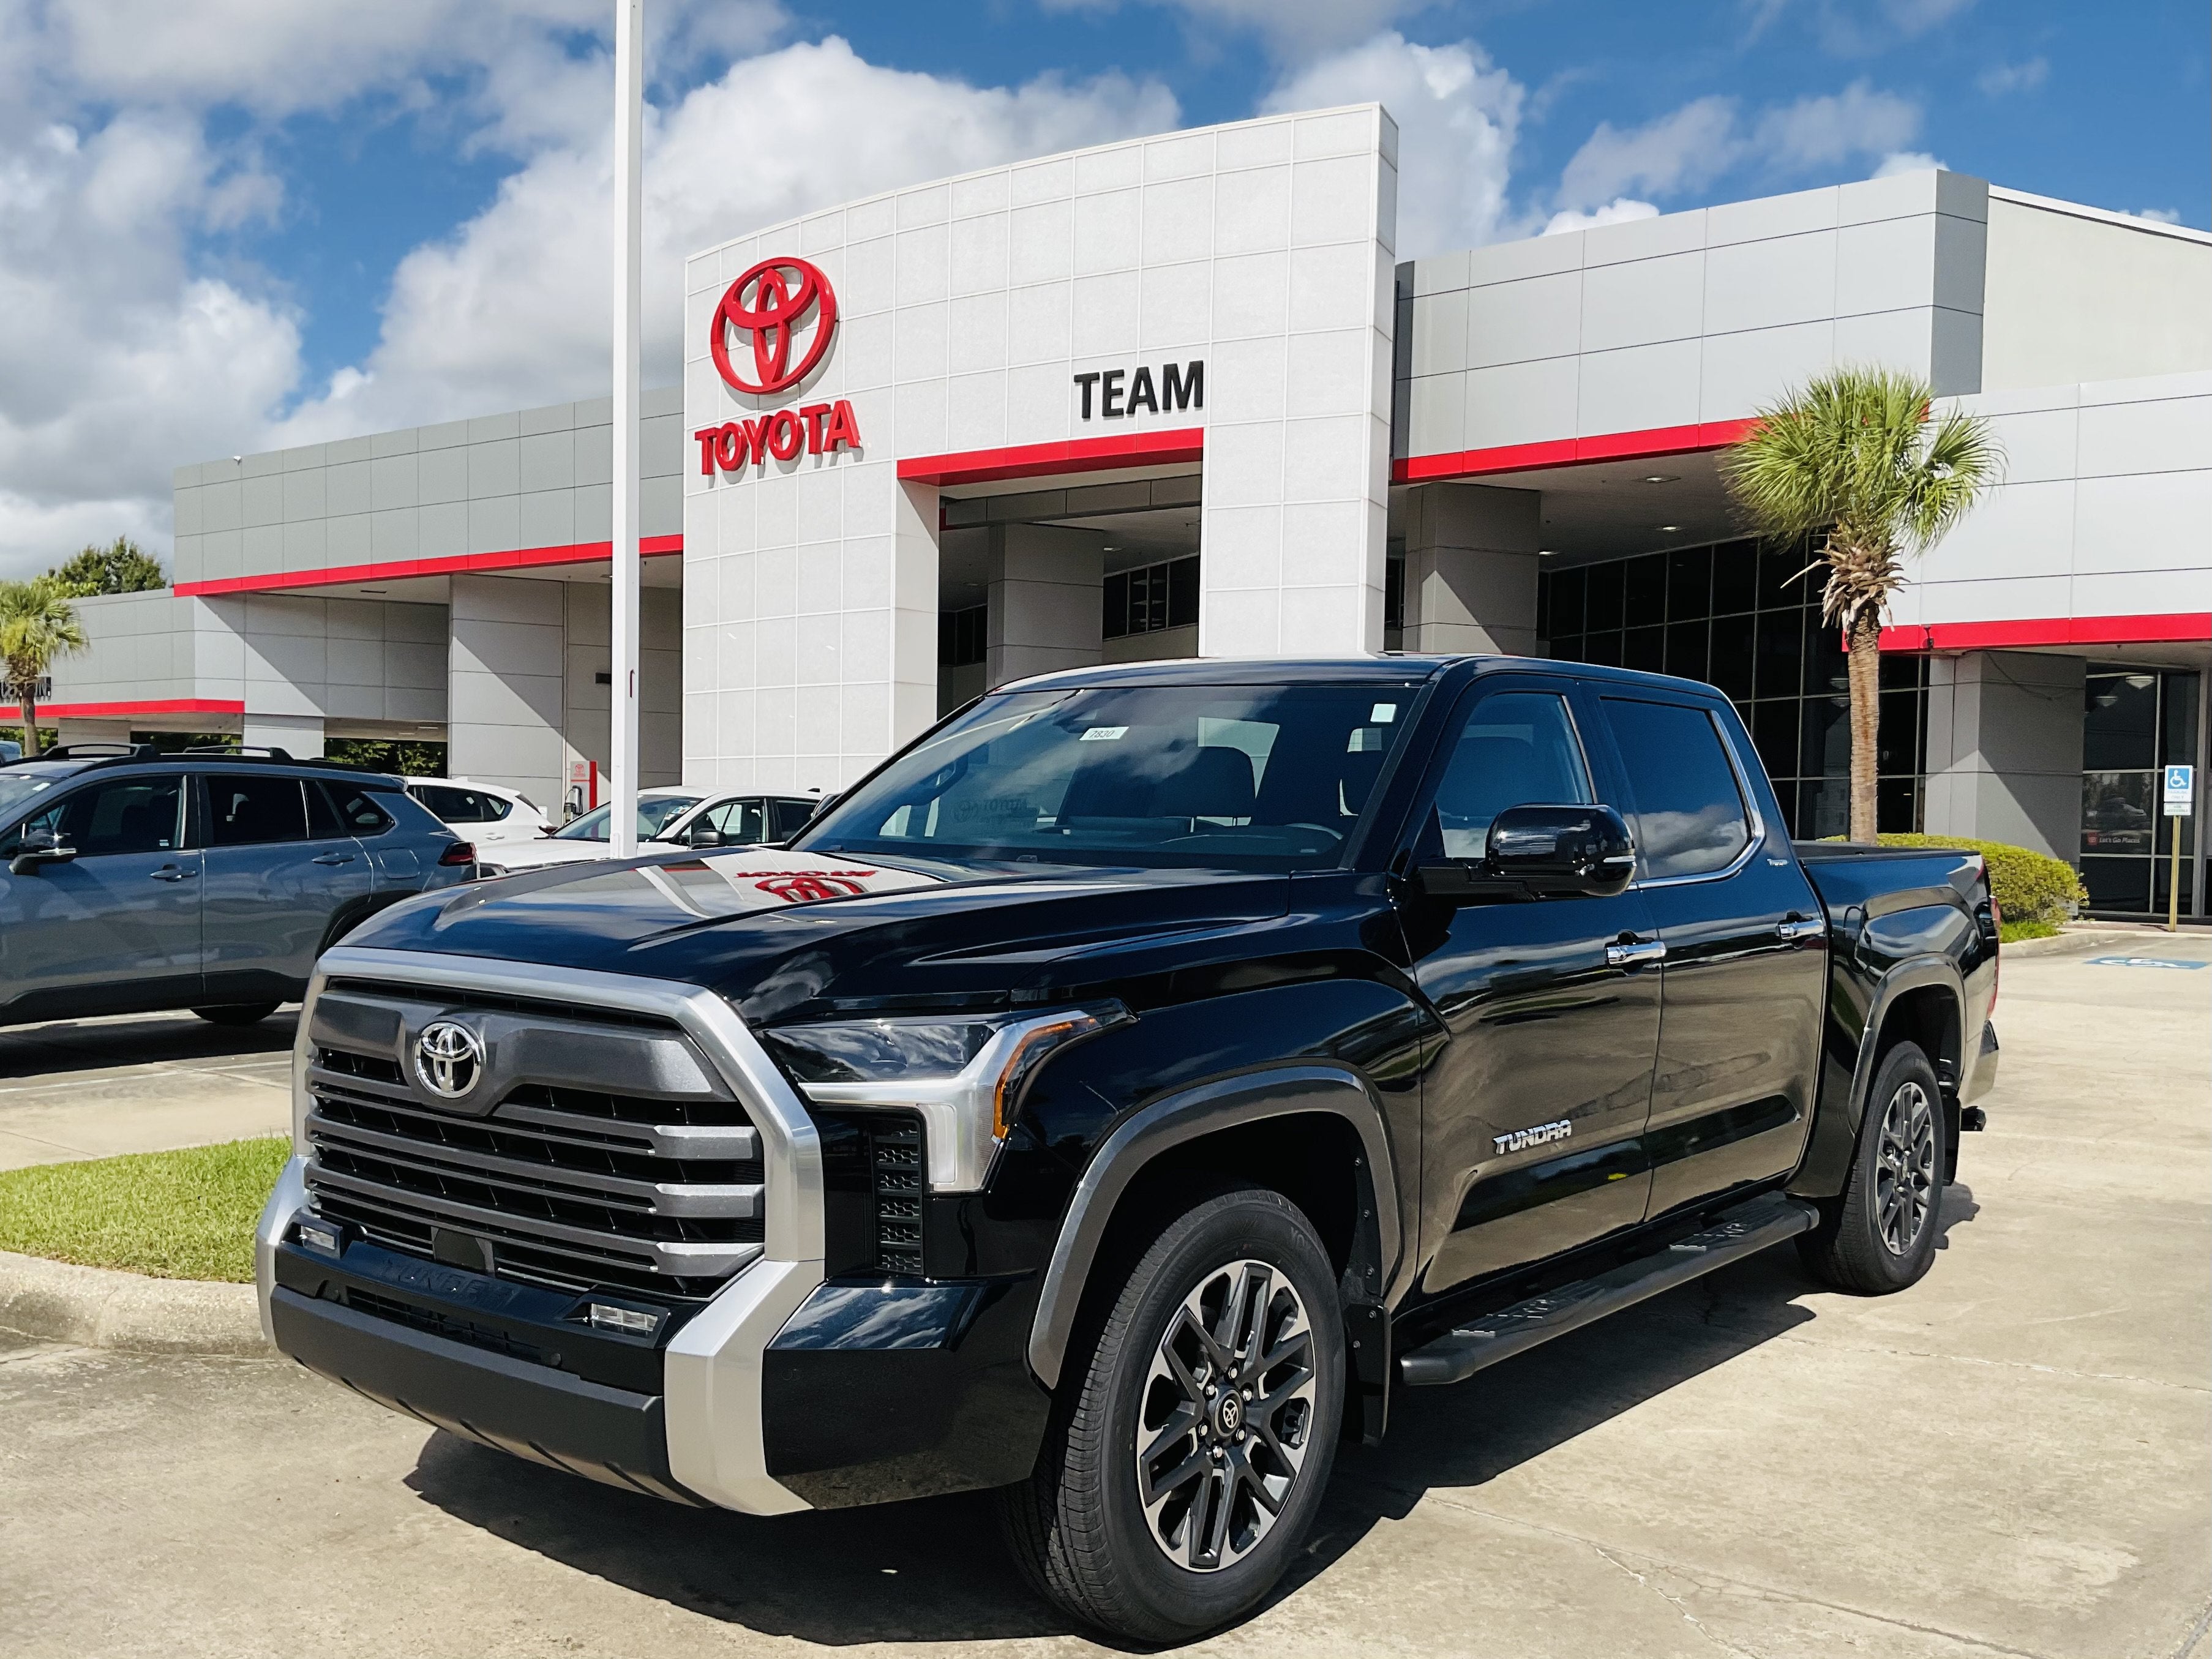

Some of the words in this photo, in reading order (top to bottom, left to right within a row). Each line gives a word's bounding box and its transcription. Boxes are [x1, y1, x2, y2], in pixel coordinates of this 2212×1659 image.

[1073, 360, 1204, 419] TEAM
[694, 400, 862, 476] TOYOTA
[1493, 1119, 1572, 1155] TUNDRA
